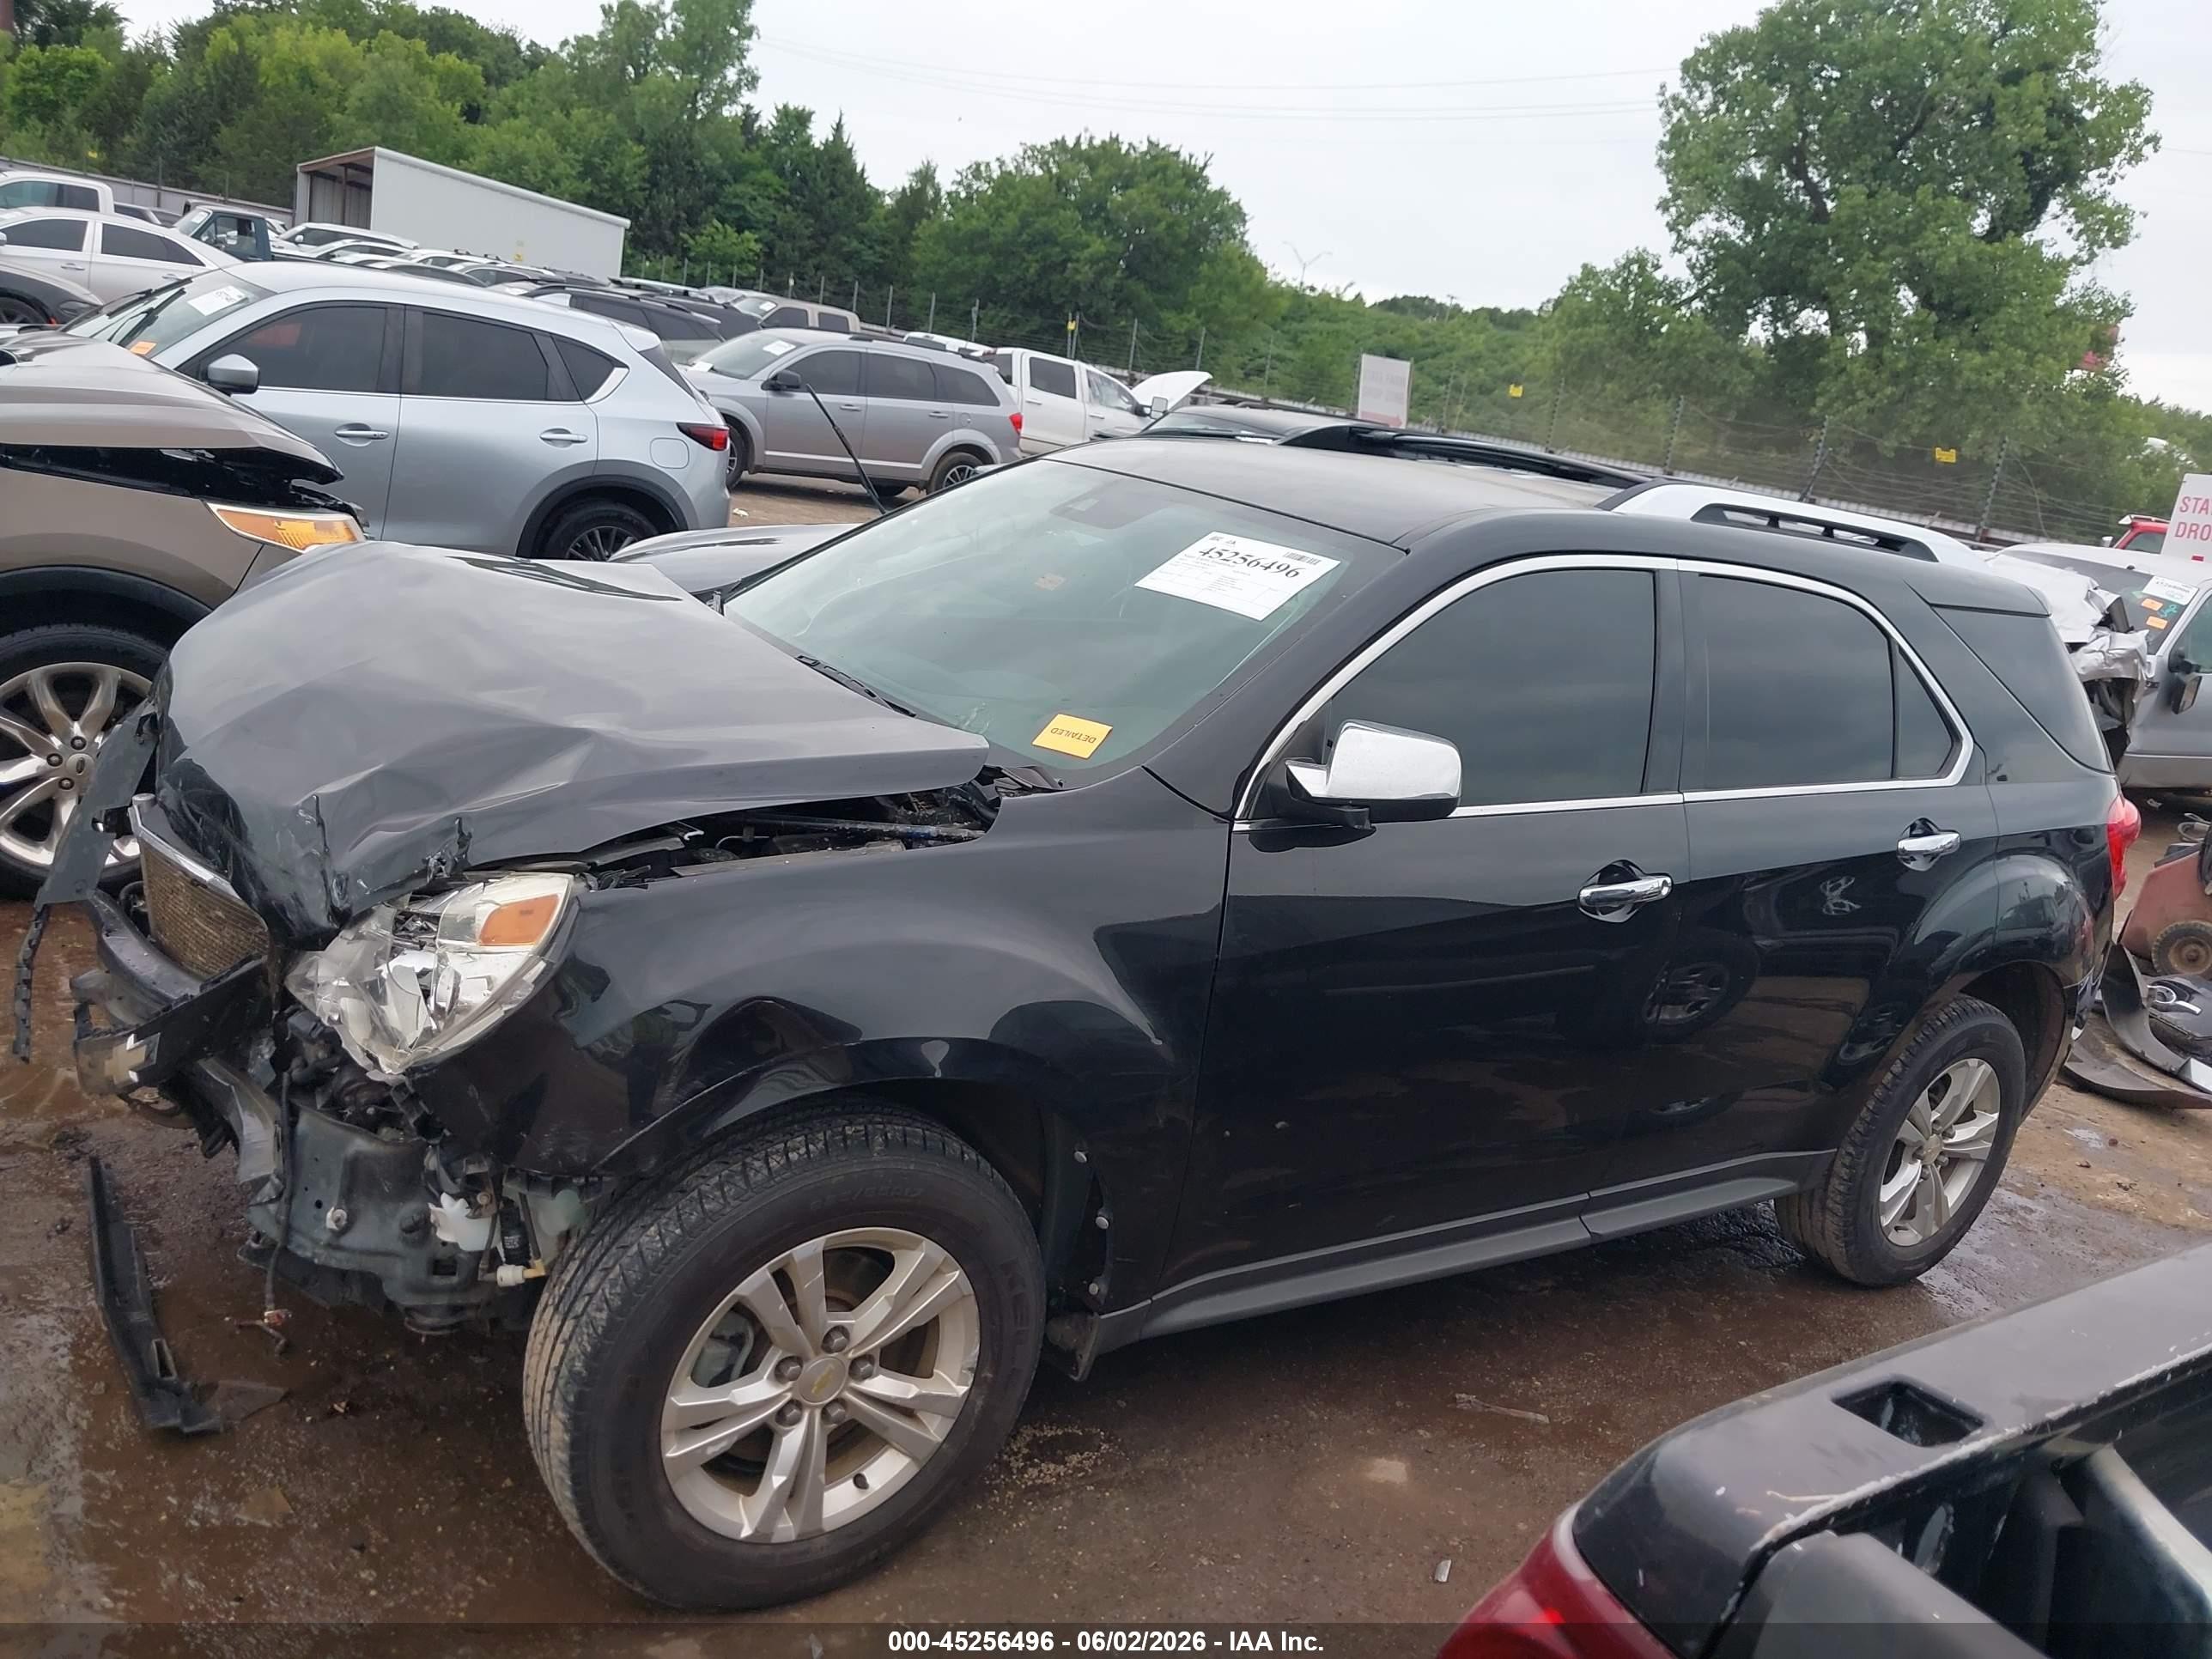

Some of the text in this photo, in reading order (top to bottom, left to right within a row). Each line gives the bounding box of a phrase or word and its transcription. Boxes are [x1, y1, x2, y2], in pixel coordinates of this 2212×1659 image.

[2179, 495, 2212, 515] STA
[2174, 521, 2212, 541] DRO
[1199, 546, 1307, 578] 45256496
[1050, 727, 1097, 744] DETAILED
